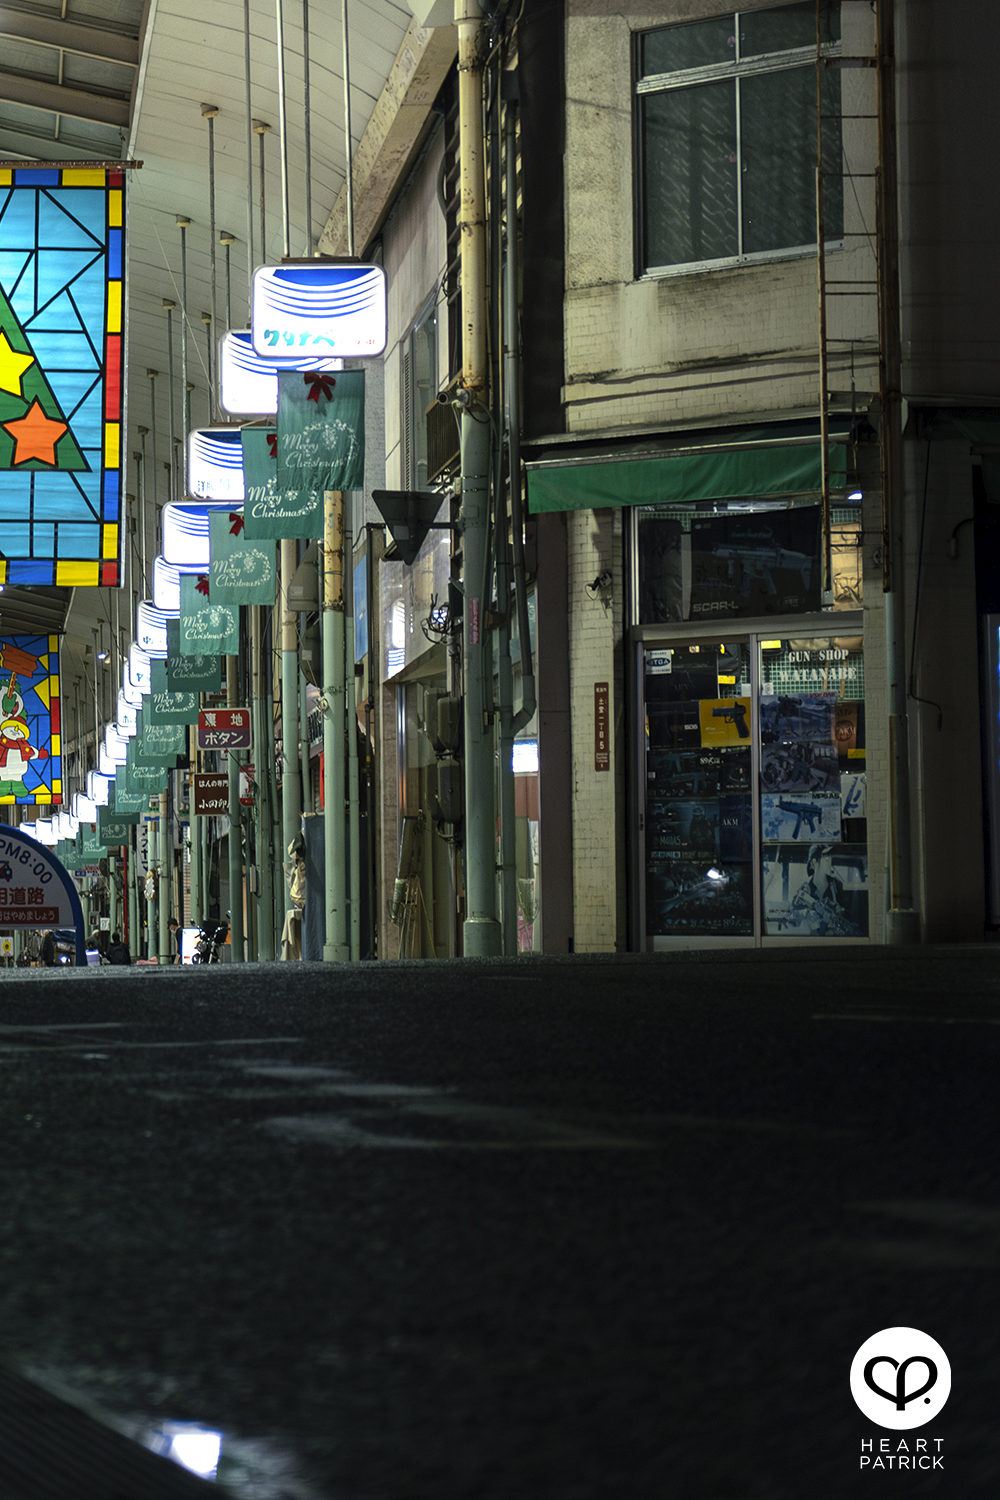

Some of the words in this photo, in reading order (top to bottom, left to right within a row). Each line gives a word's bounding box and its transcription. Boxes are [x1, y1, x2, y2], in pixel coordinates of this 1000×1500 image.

[282, 434, 318, 454] Merry
[248, 485, 281, 509] Merry
[213, 559, 241, 576] Merry
[788, 651, 811, 662] GUN
[818, 649, 849, 661] SHOP
[779, 667, 857, 682] WATANABE
[205, 731, 244, 746] ボタン
